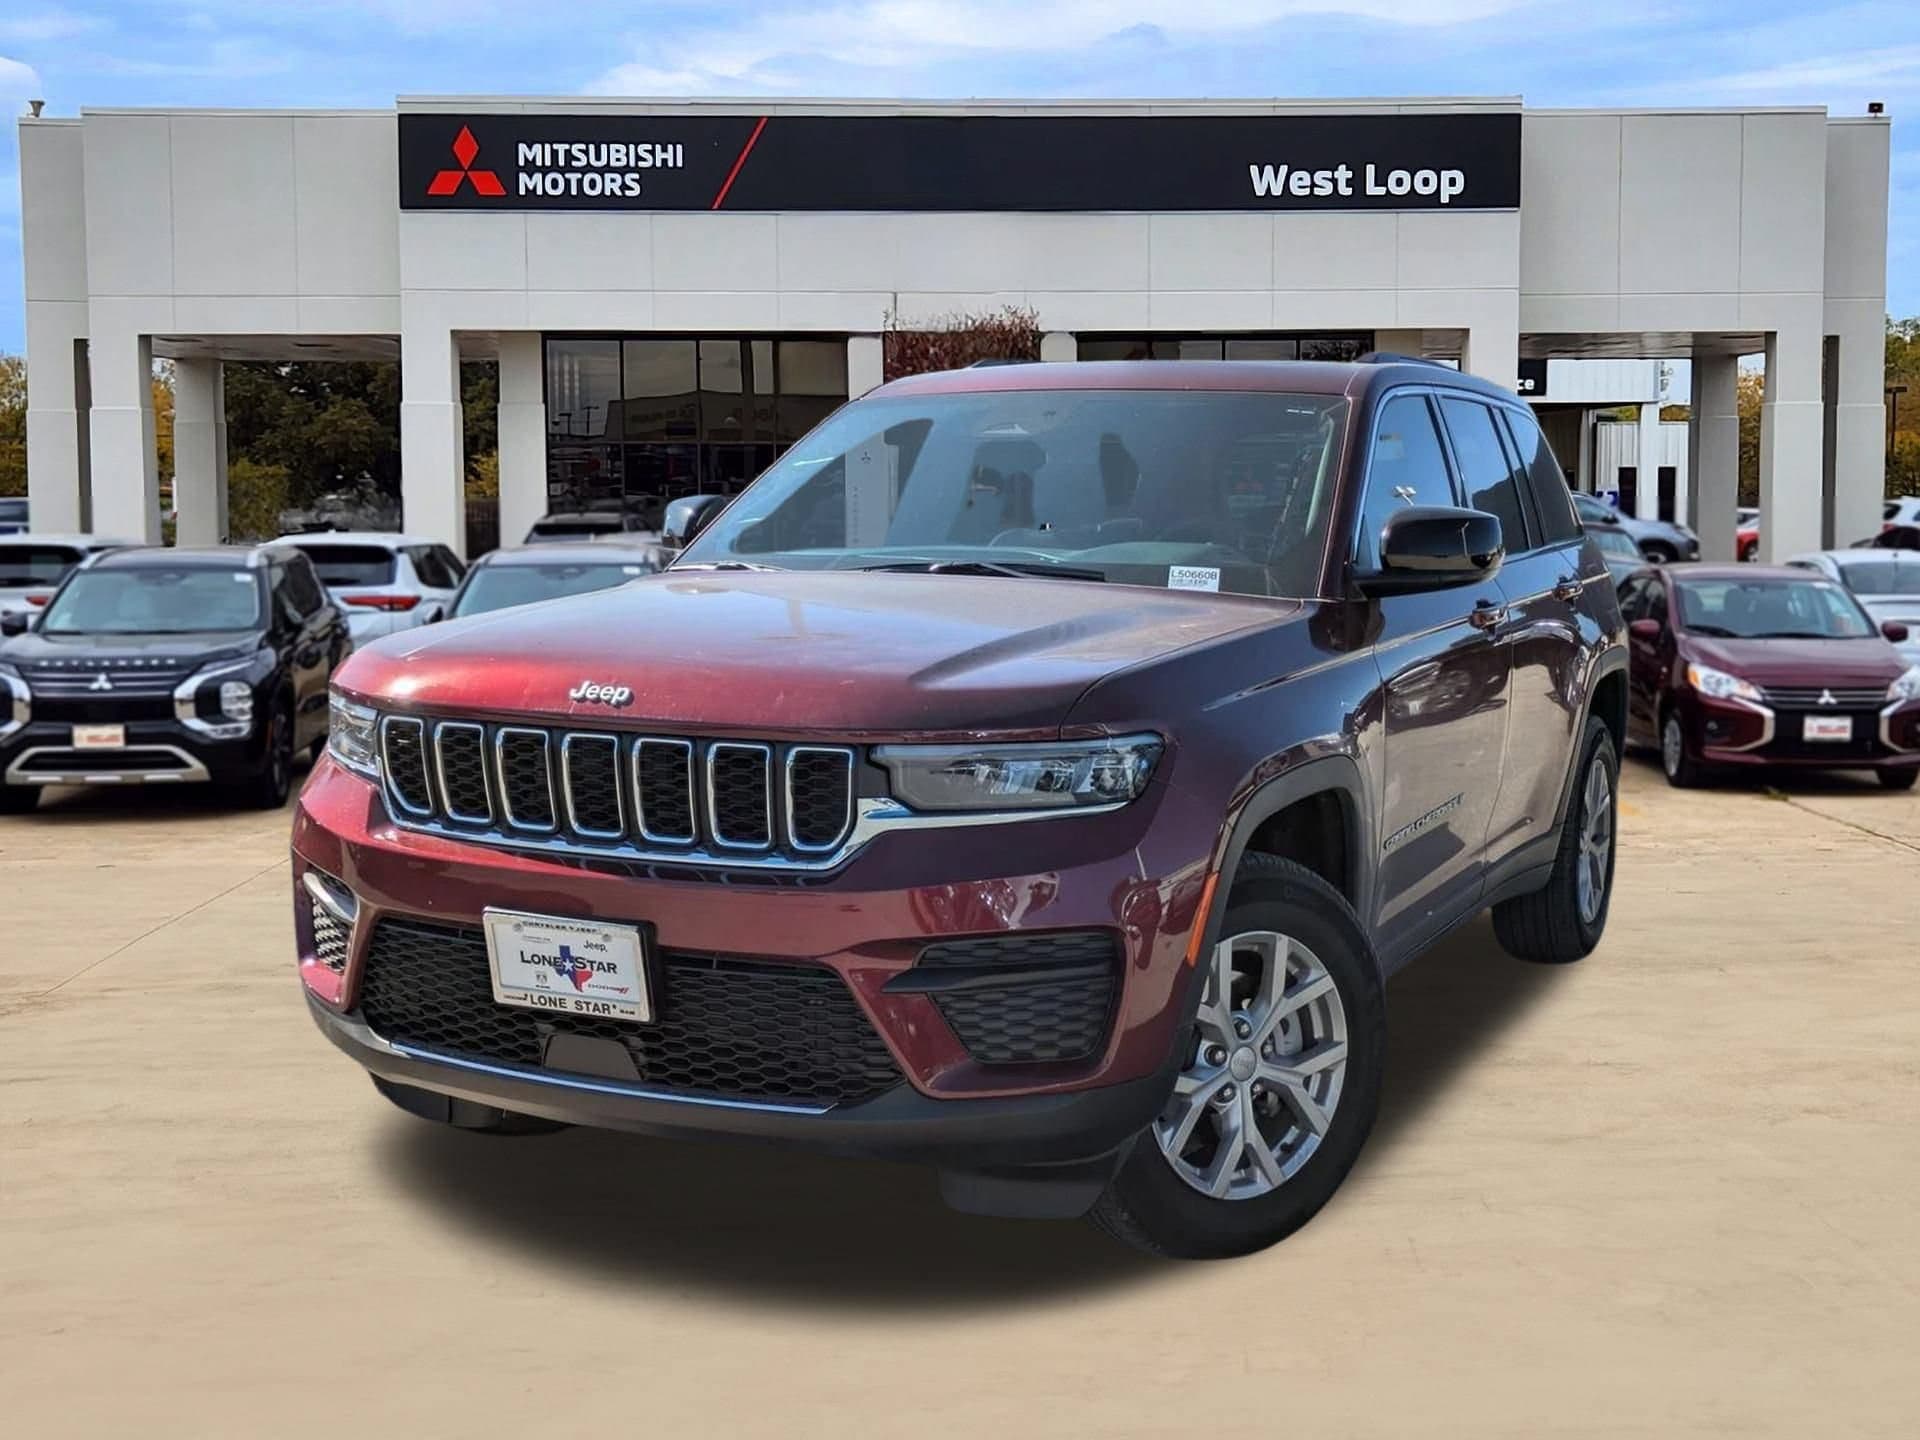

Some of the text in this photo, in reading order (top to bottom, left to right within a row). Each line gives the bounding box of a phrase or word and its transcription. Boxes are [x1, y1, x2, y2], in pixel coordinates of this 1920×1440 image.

[517, 143, 684, 168] MITSUBISHI
[518, 172, 641, 197] MOTORS
[1249, 164, 1465, 203] West Loop
[568, 680, 630, 705] Jeep
[520, 950, 618, 974] LONE STAR
[530, 993, 611, 1015] LONE STAR
